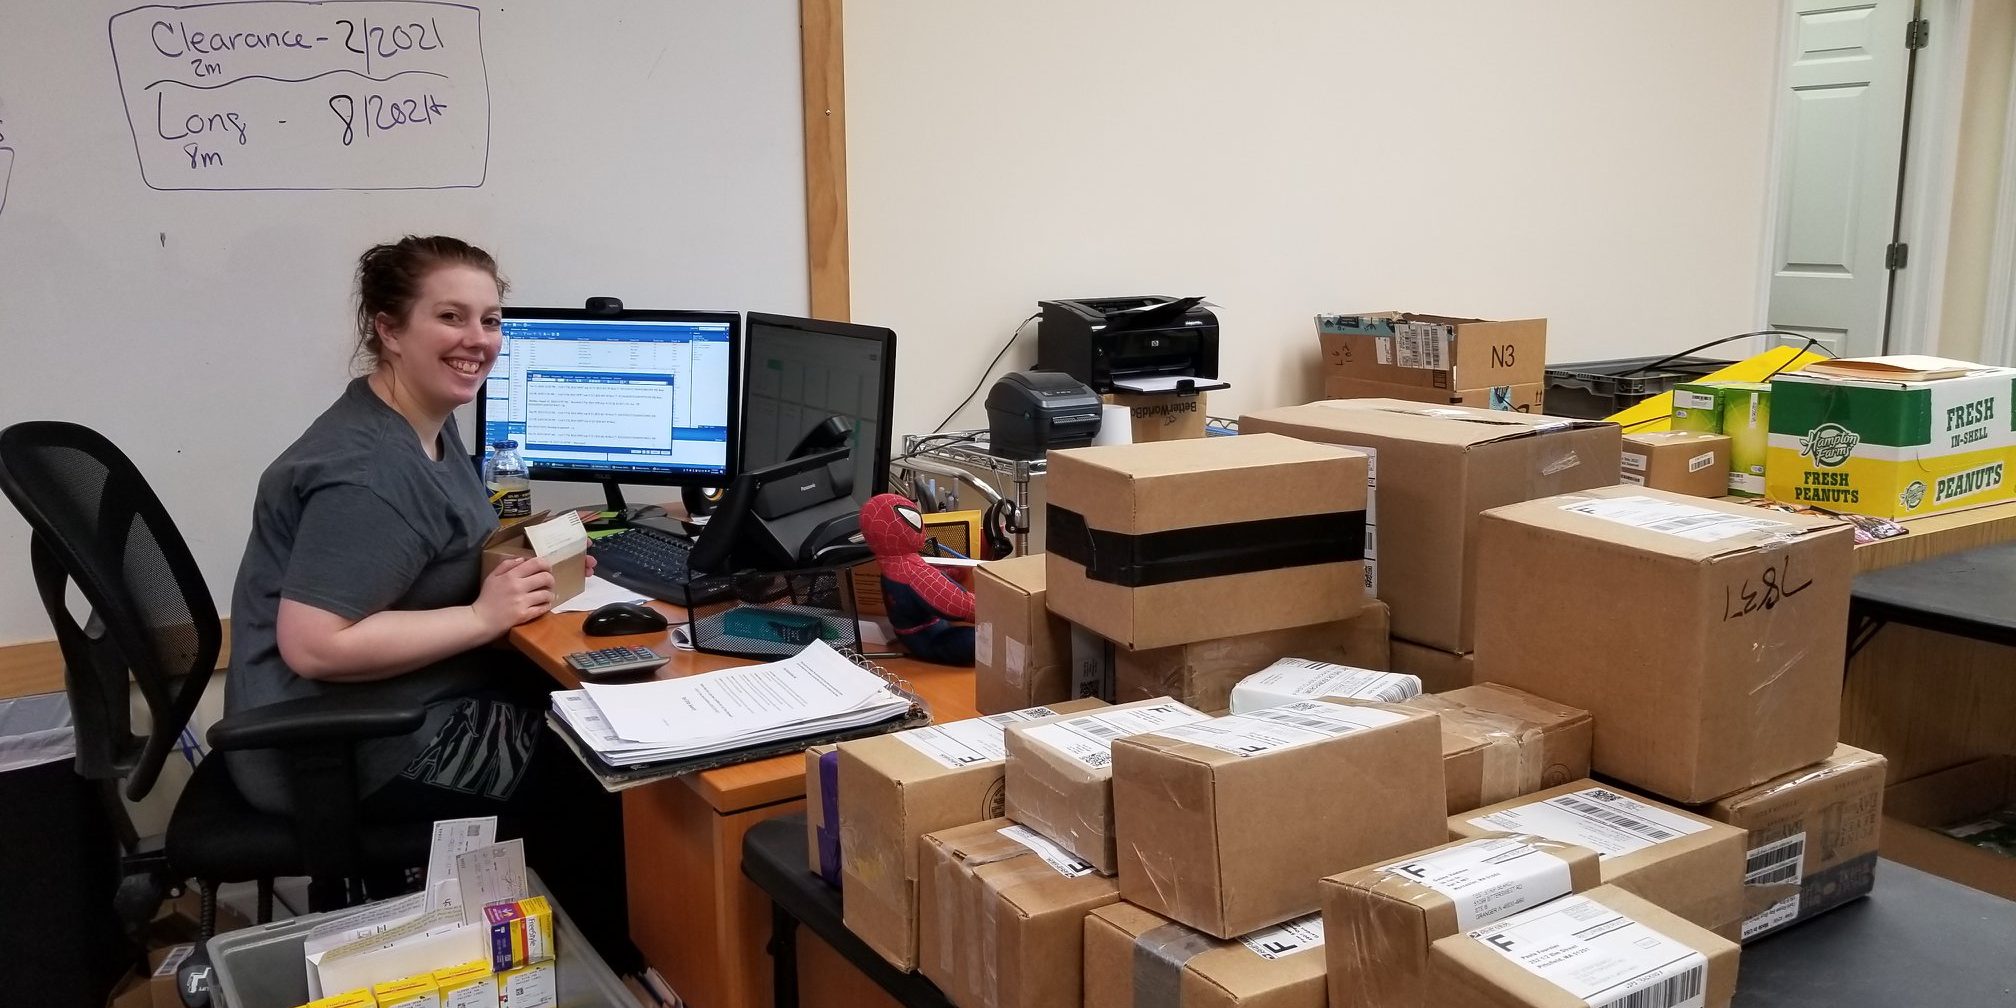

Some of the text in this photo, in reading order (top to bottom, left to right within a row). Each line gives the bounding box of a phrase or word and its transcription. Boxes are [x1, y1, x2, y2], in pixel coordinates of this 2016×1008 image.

[151, 21, 312, 57] Clearance
[335, 17, 444, 74] 2/2021
[191, 58, 222, 78] 2m
[158, 91, 247, 145] Long
[184, 145, 223, 168] 8m
[1491, 345, 1515, 369] N3
[1946, 396, 1994, 432] FRESH
[1800, 428, 1858, 456] Hampton
[1950, 427, 1988, 448] IN-SHELL
[1815, 445, 1853, 467] Farms
[1803, 471, 1850, 486] FRESH
[1935, 463, 2003, 502] PEANUTS
[1794, 487, 1859, 503] PEANUTS
[1486, 933, 1515, 952] F
